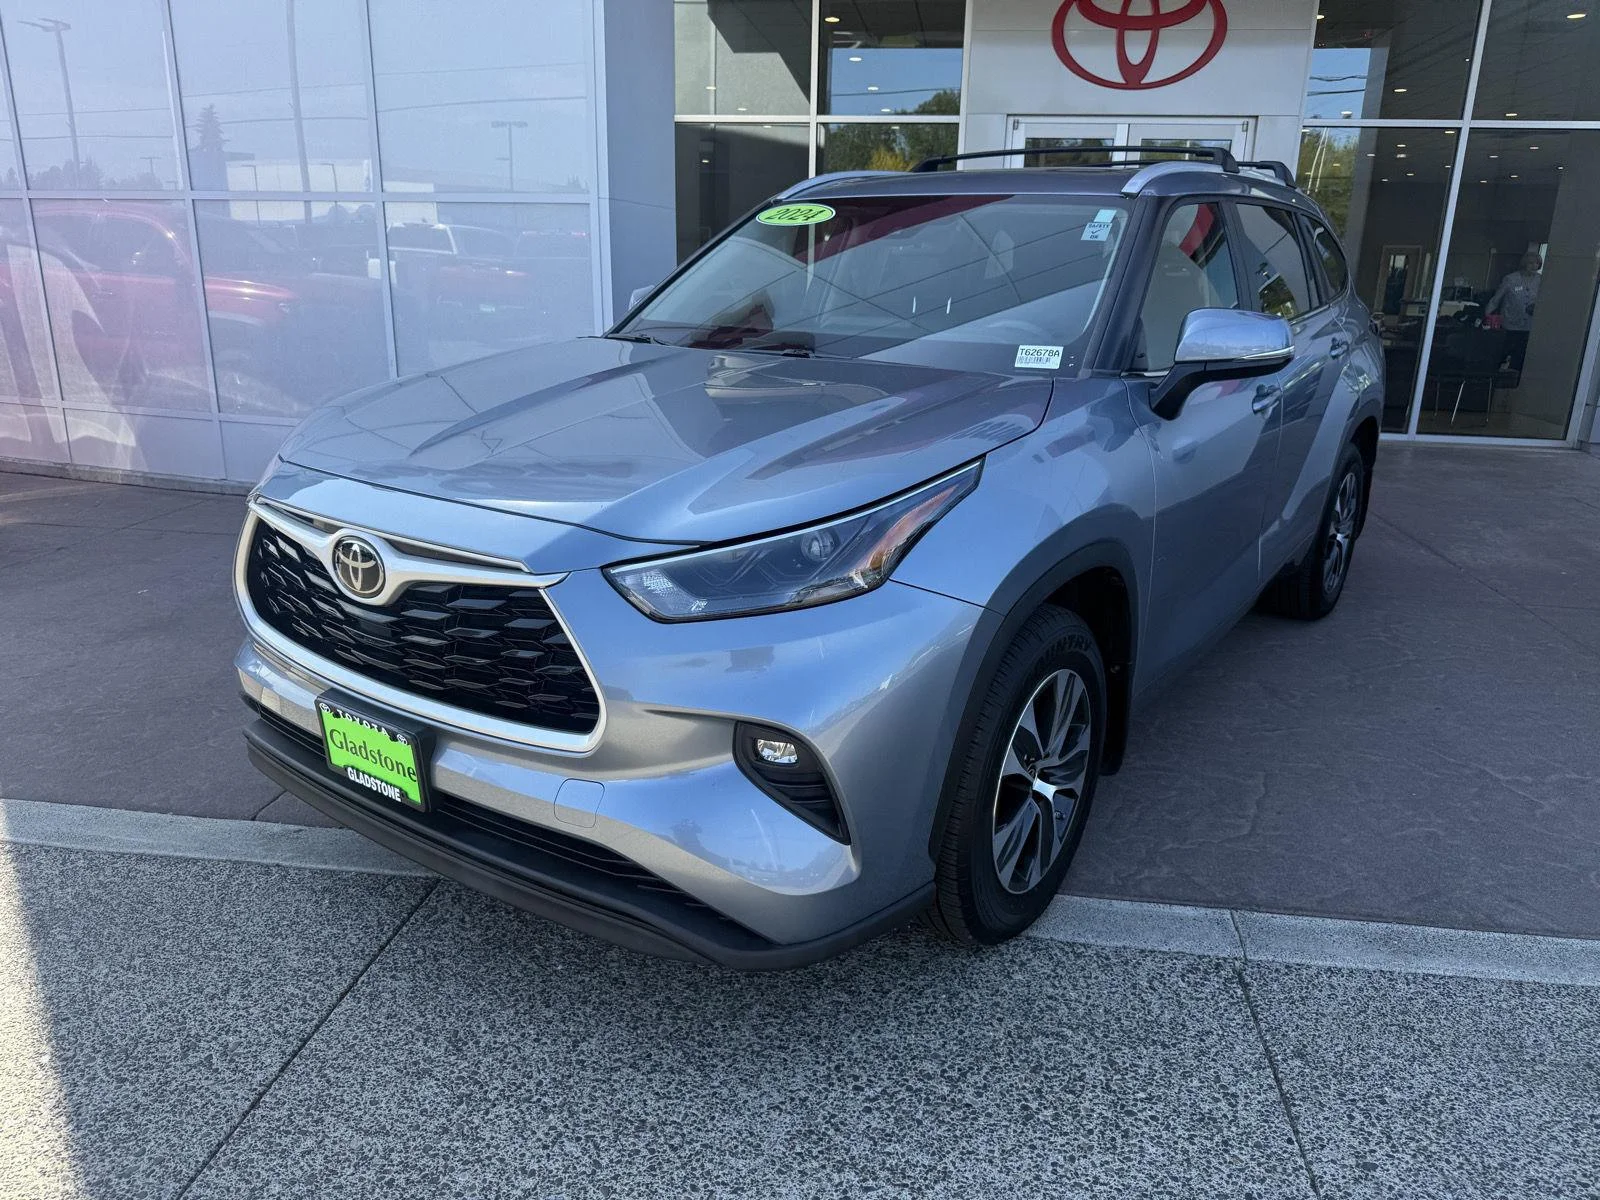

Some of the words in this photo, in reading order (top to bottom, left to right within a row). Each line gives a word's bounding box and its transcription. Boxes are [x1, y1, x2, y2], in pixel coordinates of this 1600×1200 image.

[764, 208, 826, 221] 2024
[1020, 348, 1060, 358] T62678A
[336, 709, 391, 738] TOYOTA
[329, 728, 417, 782] Gladstone
[346, 766, 402, 803] GLADSTONE
